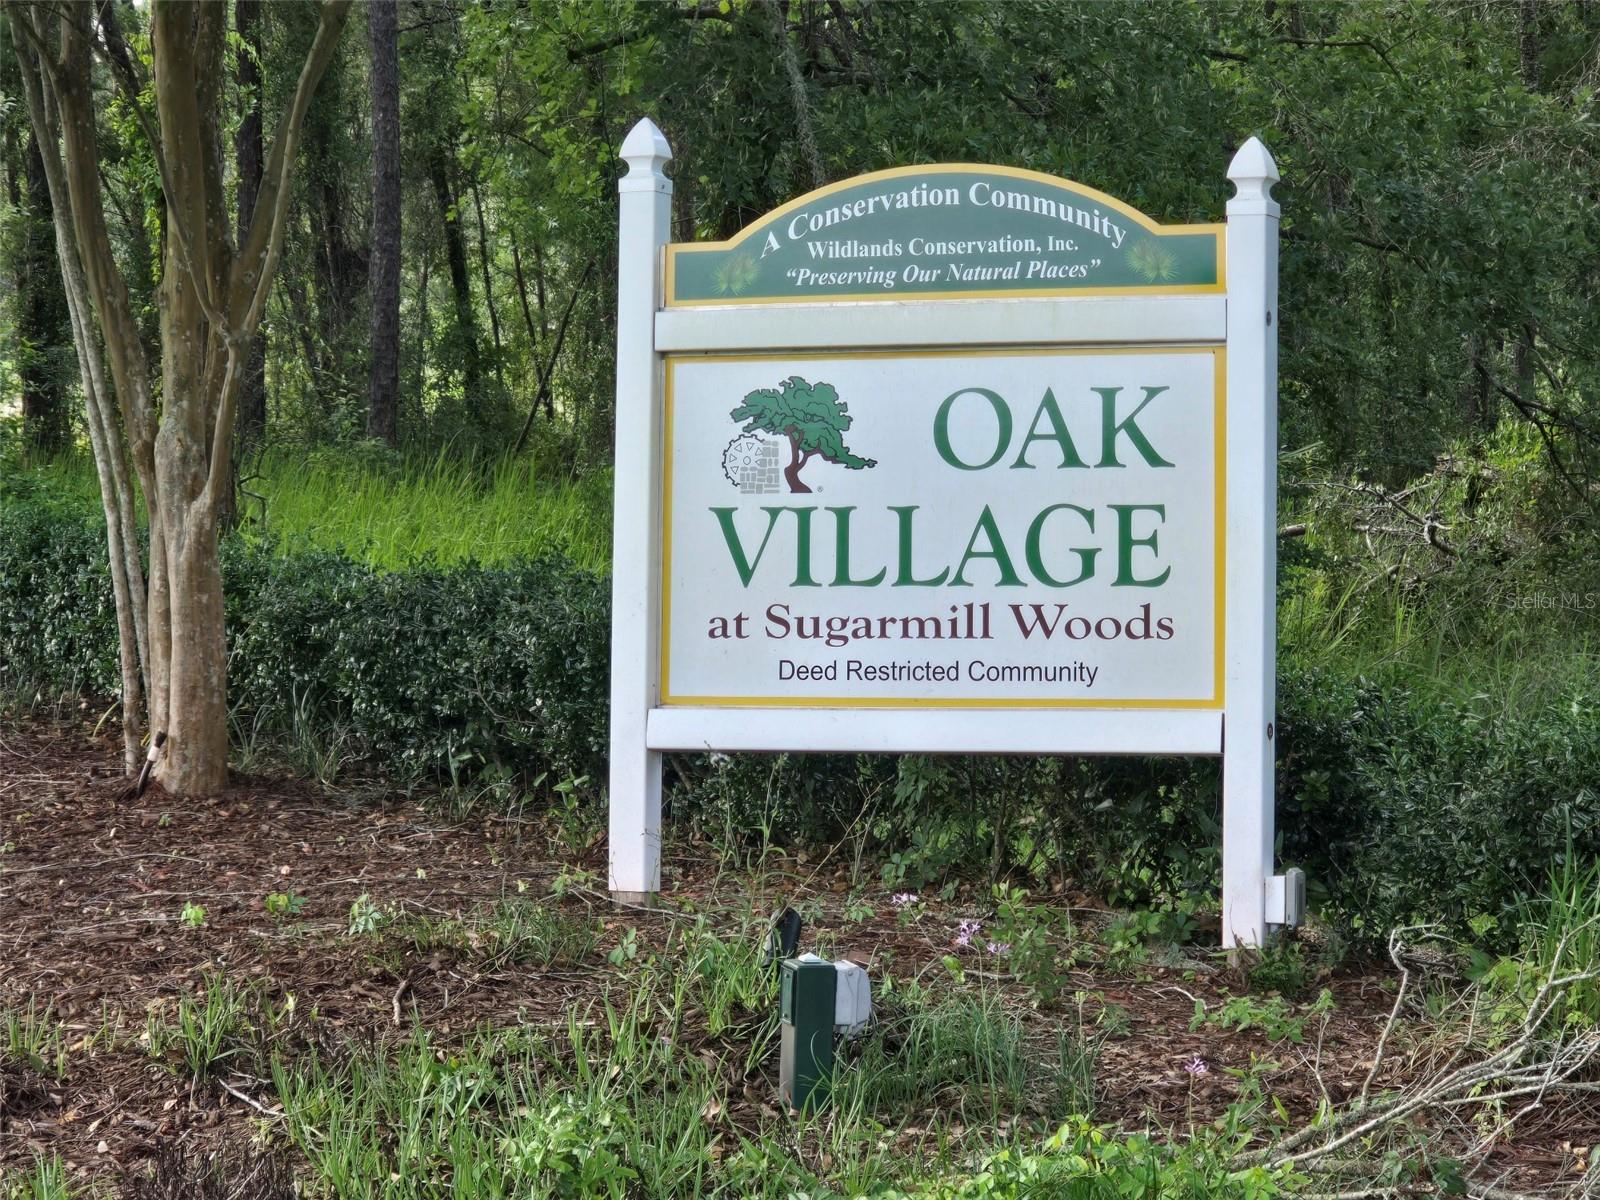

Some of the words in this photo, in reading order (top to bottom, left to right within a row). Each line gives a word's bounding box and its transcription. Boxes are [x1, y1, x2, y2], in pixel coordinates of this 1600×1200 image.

[759, 231, 782, 258] A
[787, 183, 961, 241] Conservation
[968, 182, 1128, 250] Community
[807, 235, 902, 259] Wildlands
[908, 235, 1042, 258] Conservation,
[1048, 233, 1079, 252] Inc.
[786, 265, 897, 290] “Preserving
[903, 264, 941, 284] Our
[945, 261, 1020, 283] Natural
[1025, 259, 1101, 281] Places”
[933, 386, 1176, 470] OAK
[708, 503, 1172, 588] VILLAGE
[708, 611, 750, 640] at
[765, 602, 994, 648] Sugarmill
[1008, 602, 1175, 641] Woods
[778, 660, 838, 683] Deed
[846, 660, 960, 683] Restricted
[968, 660, 1099, 688] Community
